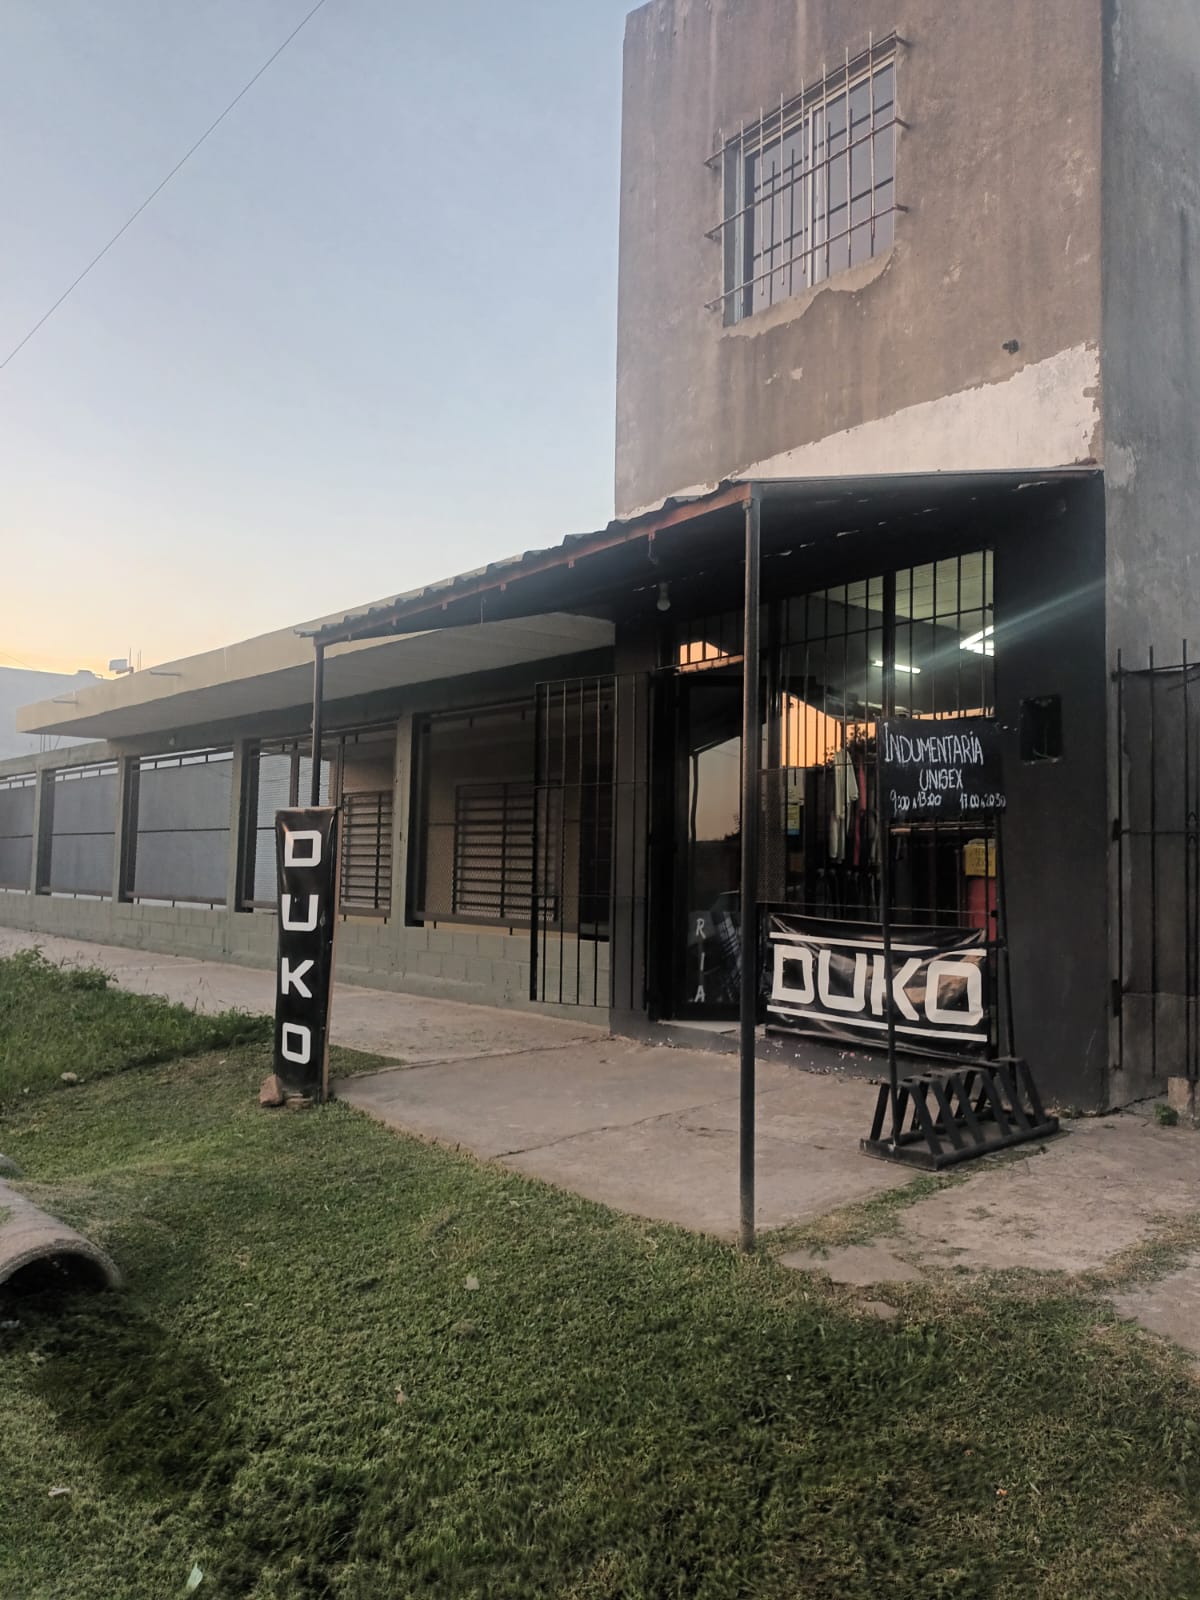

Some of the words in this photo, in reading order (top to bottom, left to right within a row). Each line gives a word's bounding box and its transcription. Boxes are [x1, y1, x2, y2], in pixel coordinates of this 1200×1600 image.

[919, 768, 963, 791] UNISEX
[281, 830, 322, 1065] DUKO
[771, 943, 984, 1027] DUKO
